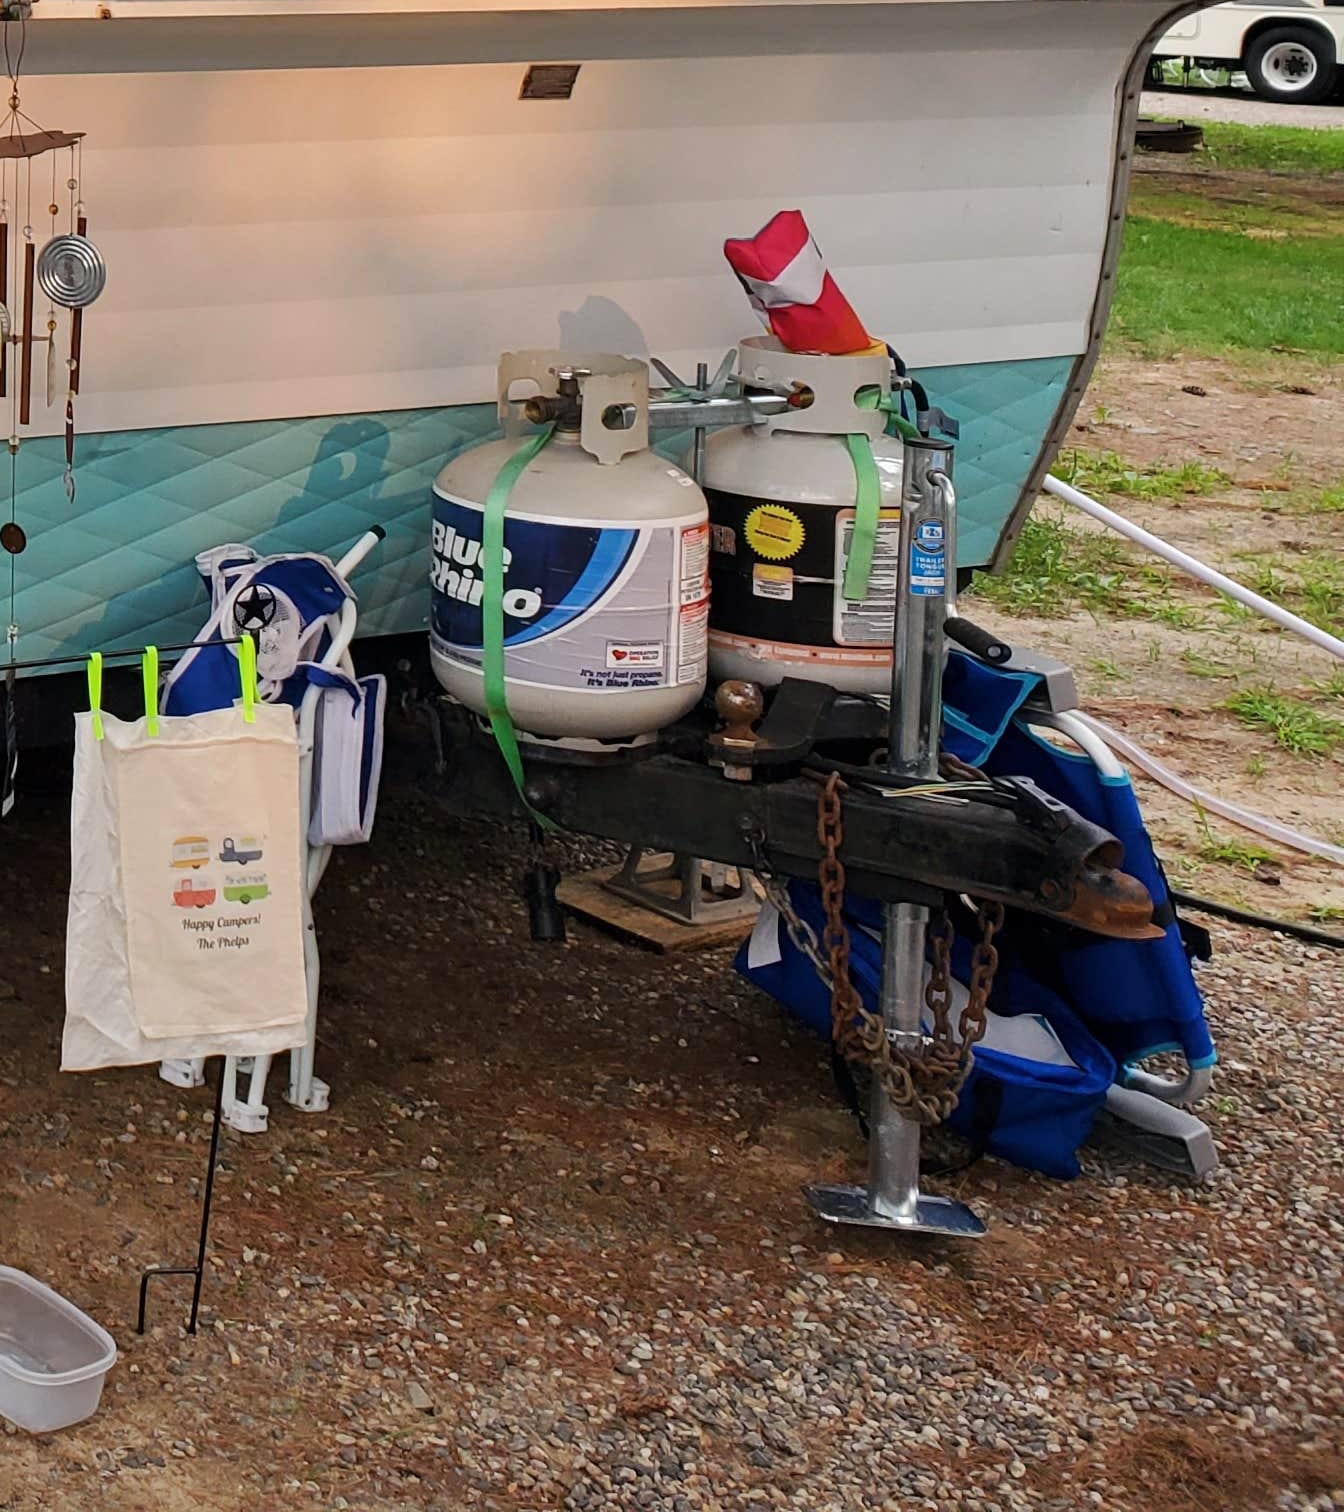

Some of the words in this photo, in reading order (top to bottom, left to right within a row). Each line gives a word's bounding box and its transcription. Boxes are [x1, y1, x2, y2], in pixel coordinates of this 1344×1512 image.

[612, 671, 629, 679] just
[606, 679, 629, 687] Blue
[182, 918, 214, 931] Happy
[217, 913, 262, 928] Campers!
[197, 937, 215, 949] The
[217, 936, 250, 949] Phelps
